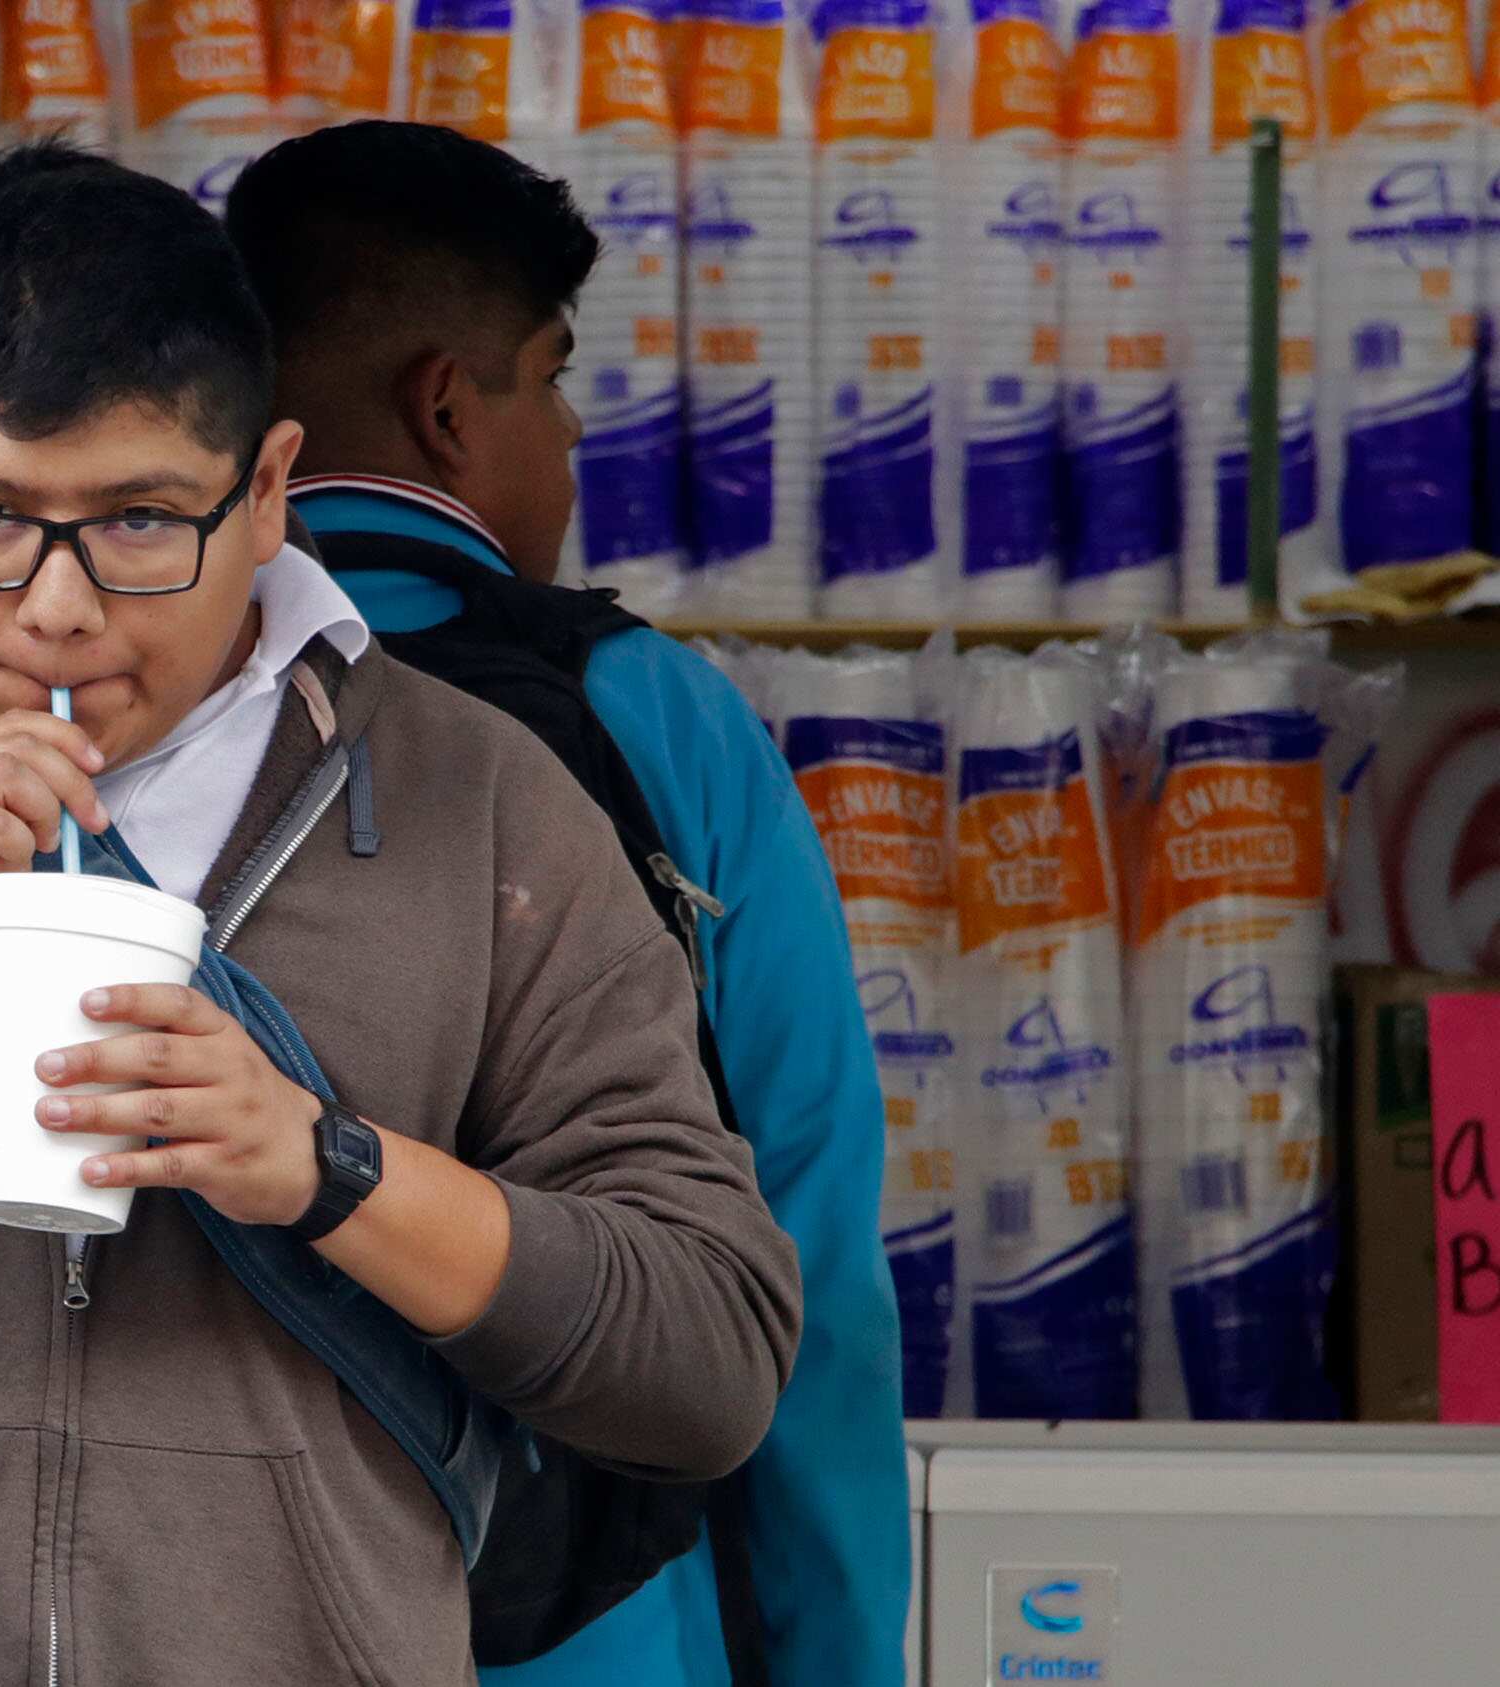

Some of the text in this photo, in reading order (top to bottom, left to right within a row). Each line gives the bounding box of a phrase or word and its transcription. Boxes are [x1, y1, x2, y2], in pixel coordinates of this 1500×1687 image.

[827, 779, 939, 831] ENVASE
[1170, 776, 1284, 828] ENVASE
[1170, 829, 1293, 878] TÉRMICO
[1000, 1652, 1100, 1681] Crintec
